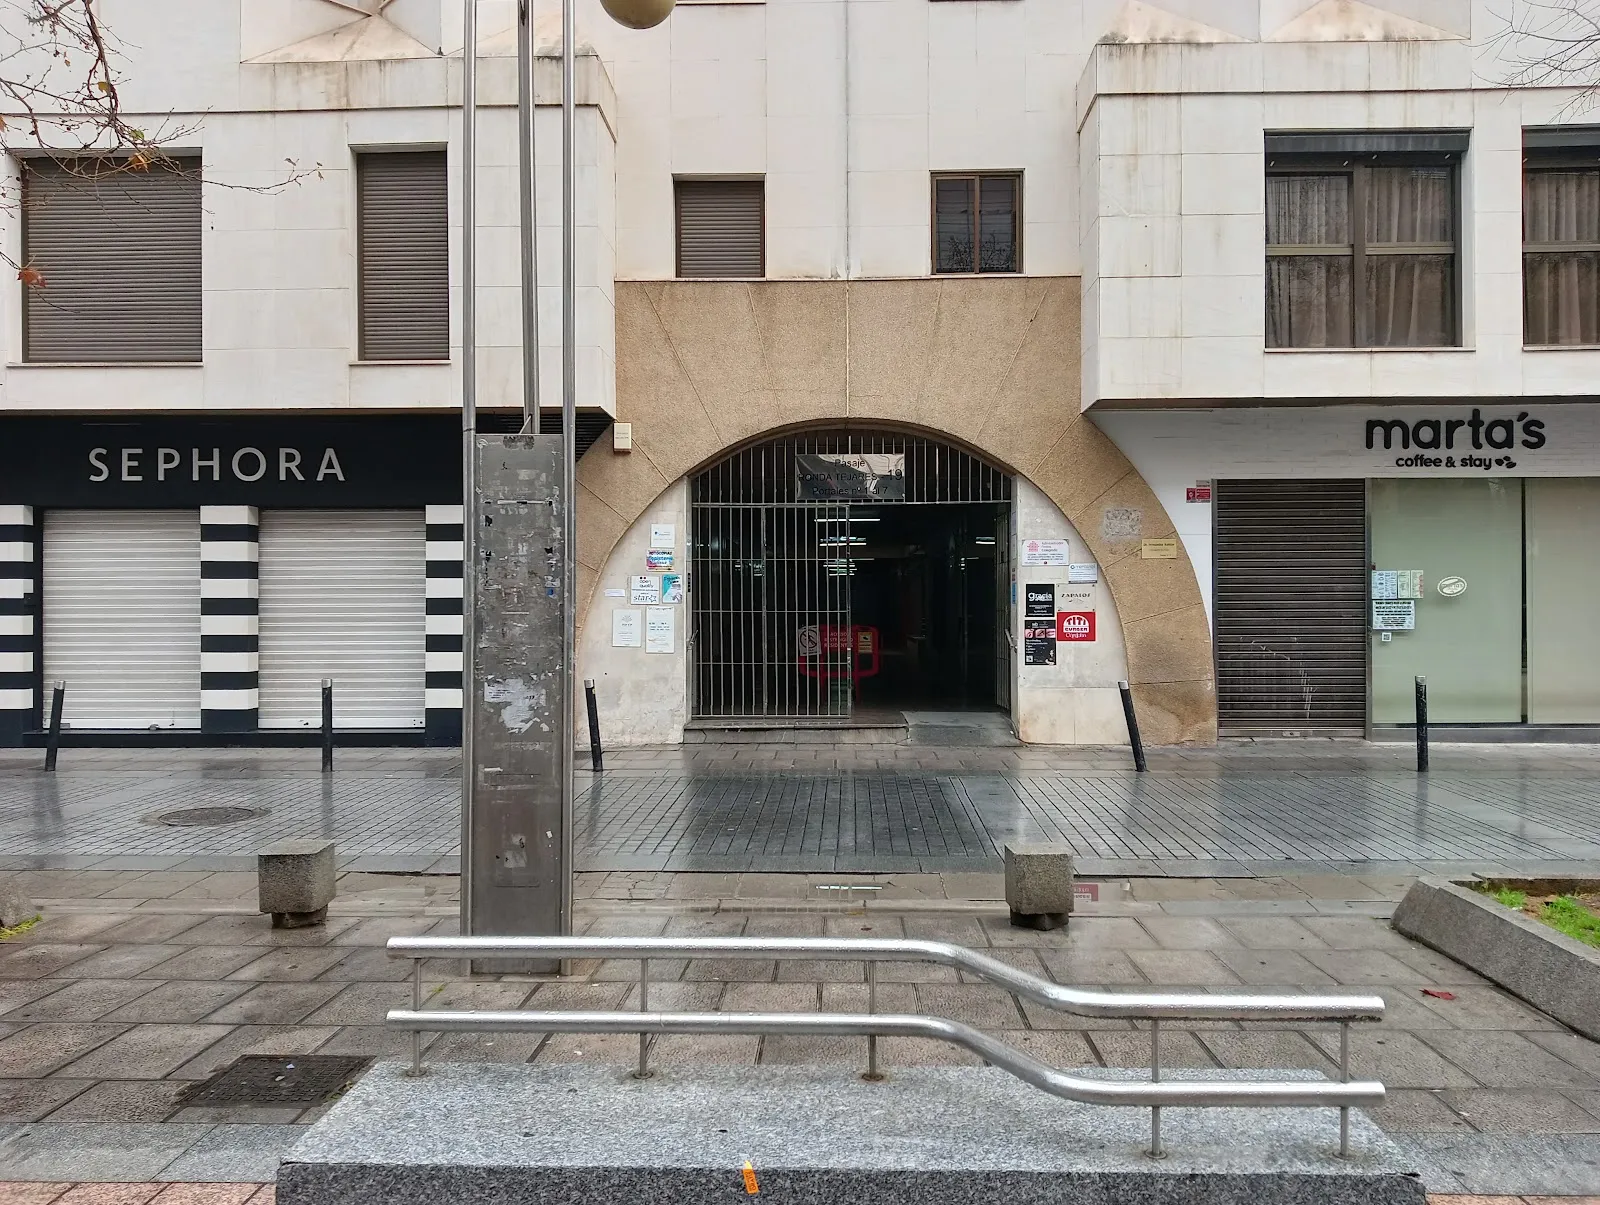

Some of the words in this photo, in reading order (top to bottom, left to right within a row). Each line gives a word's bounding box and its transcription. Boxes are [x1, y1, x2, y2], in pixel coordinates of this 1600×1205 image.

[88, 447, 346, 482] SEPHORA
[834, 459, 866, 469] Pasaje
[1396, 454, 1443, 468] coffee
[1445, 456, 1456, 468] &
[1460, 454, 1492, 471] stay
[798, 473, 832, 481] RONDA
[835, 472, 878, 481] TEJARES
[888, 468, 903, 481] 19
[812, 486, 849, 495] Portales
[873, 487, 880, 495] al
[883, 487, 889, 495] 7
